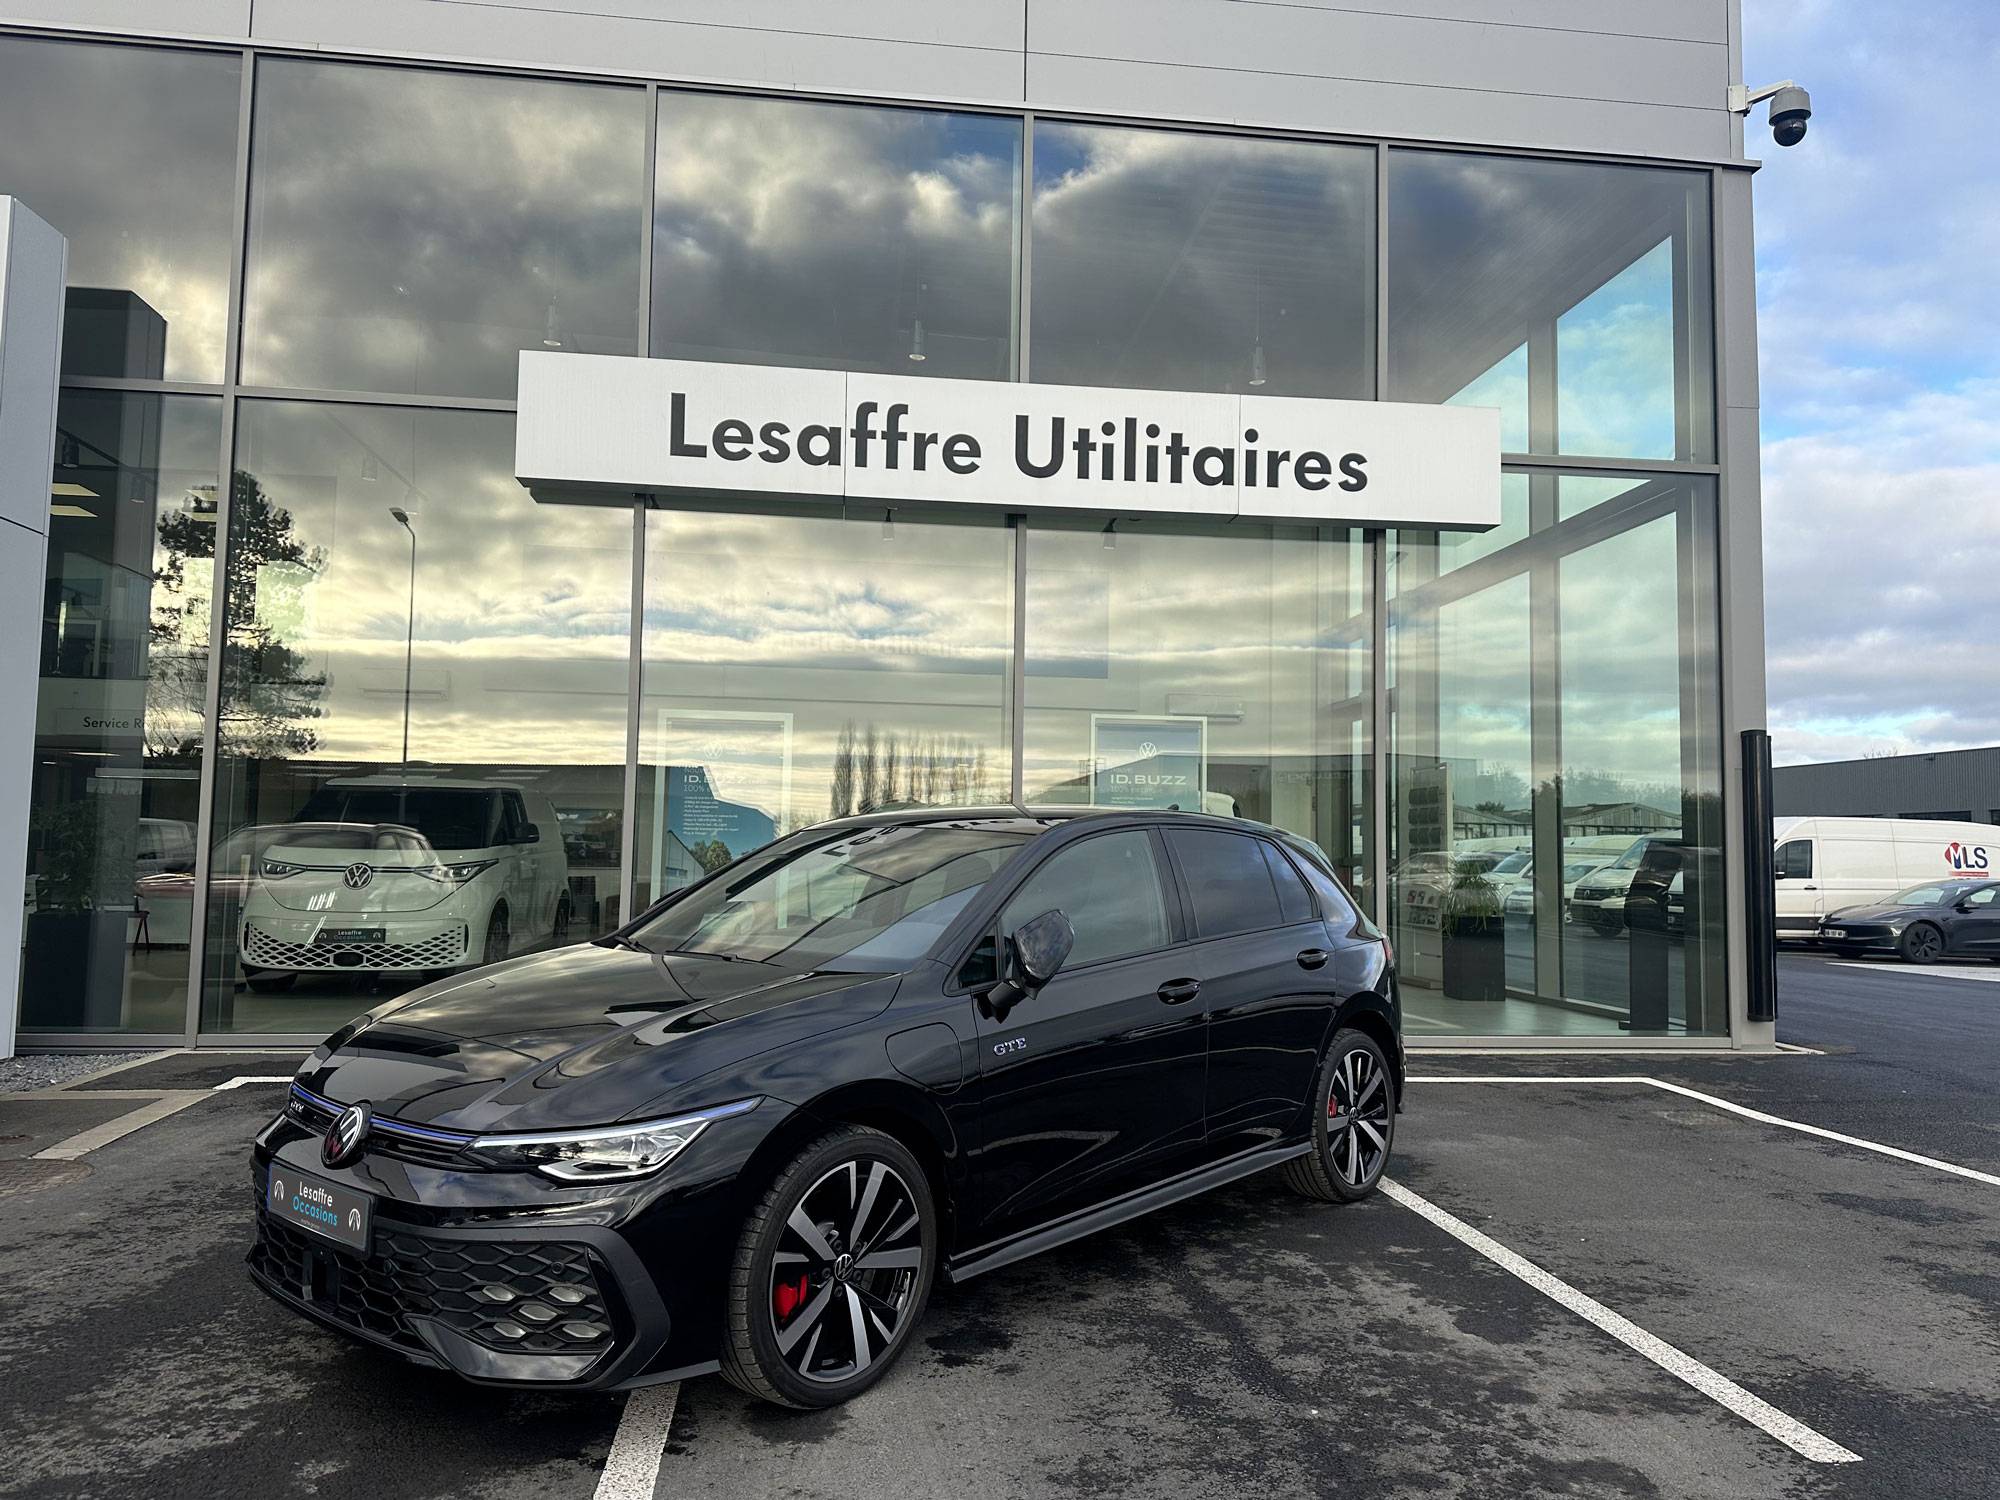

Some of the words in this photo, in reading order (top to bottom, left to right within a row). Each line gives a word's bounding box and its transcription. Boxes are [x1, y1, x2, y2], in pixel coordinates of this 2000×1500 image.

[670, 392, 982, 475] Lesaffre
[1015, 414, 1369, 492] Utilitaires
[83, 716, 129, 729] Service
[993, 1037, 1027, 1056] GTE
[299, 1181, 333, 1207] Lesaffre
[293, 1195, 338, 1226] Occasions
